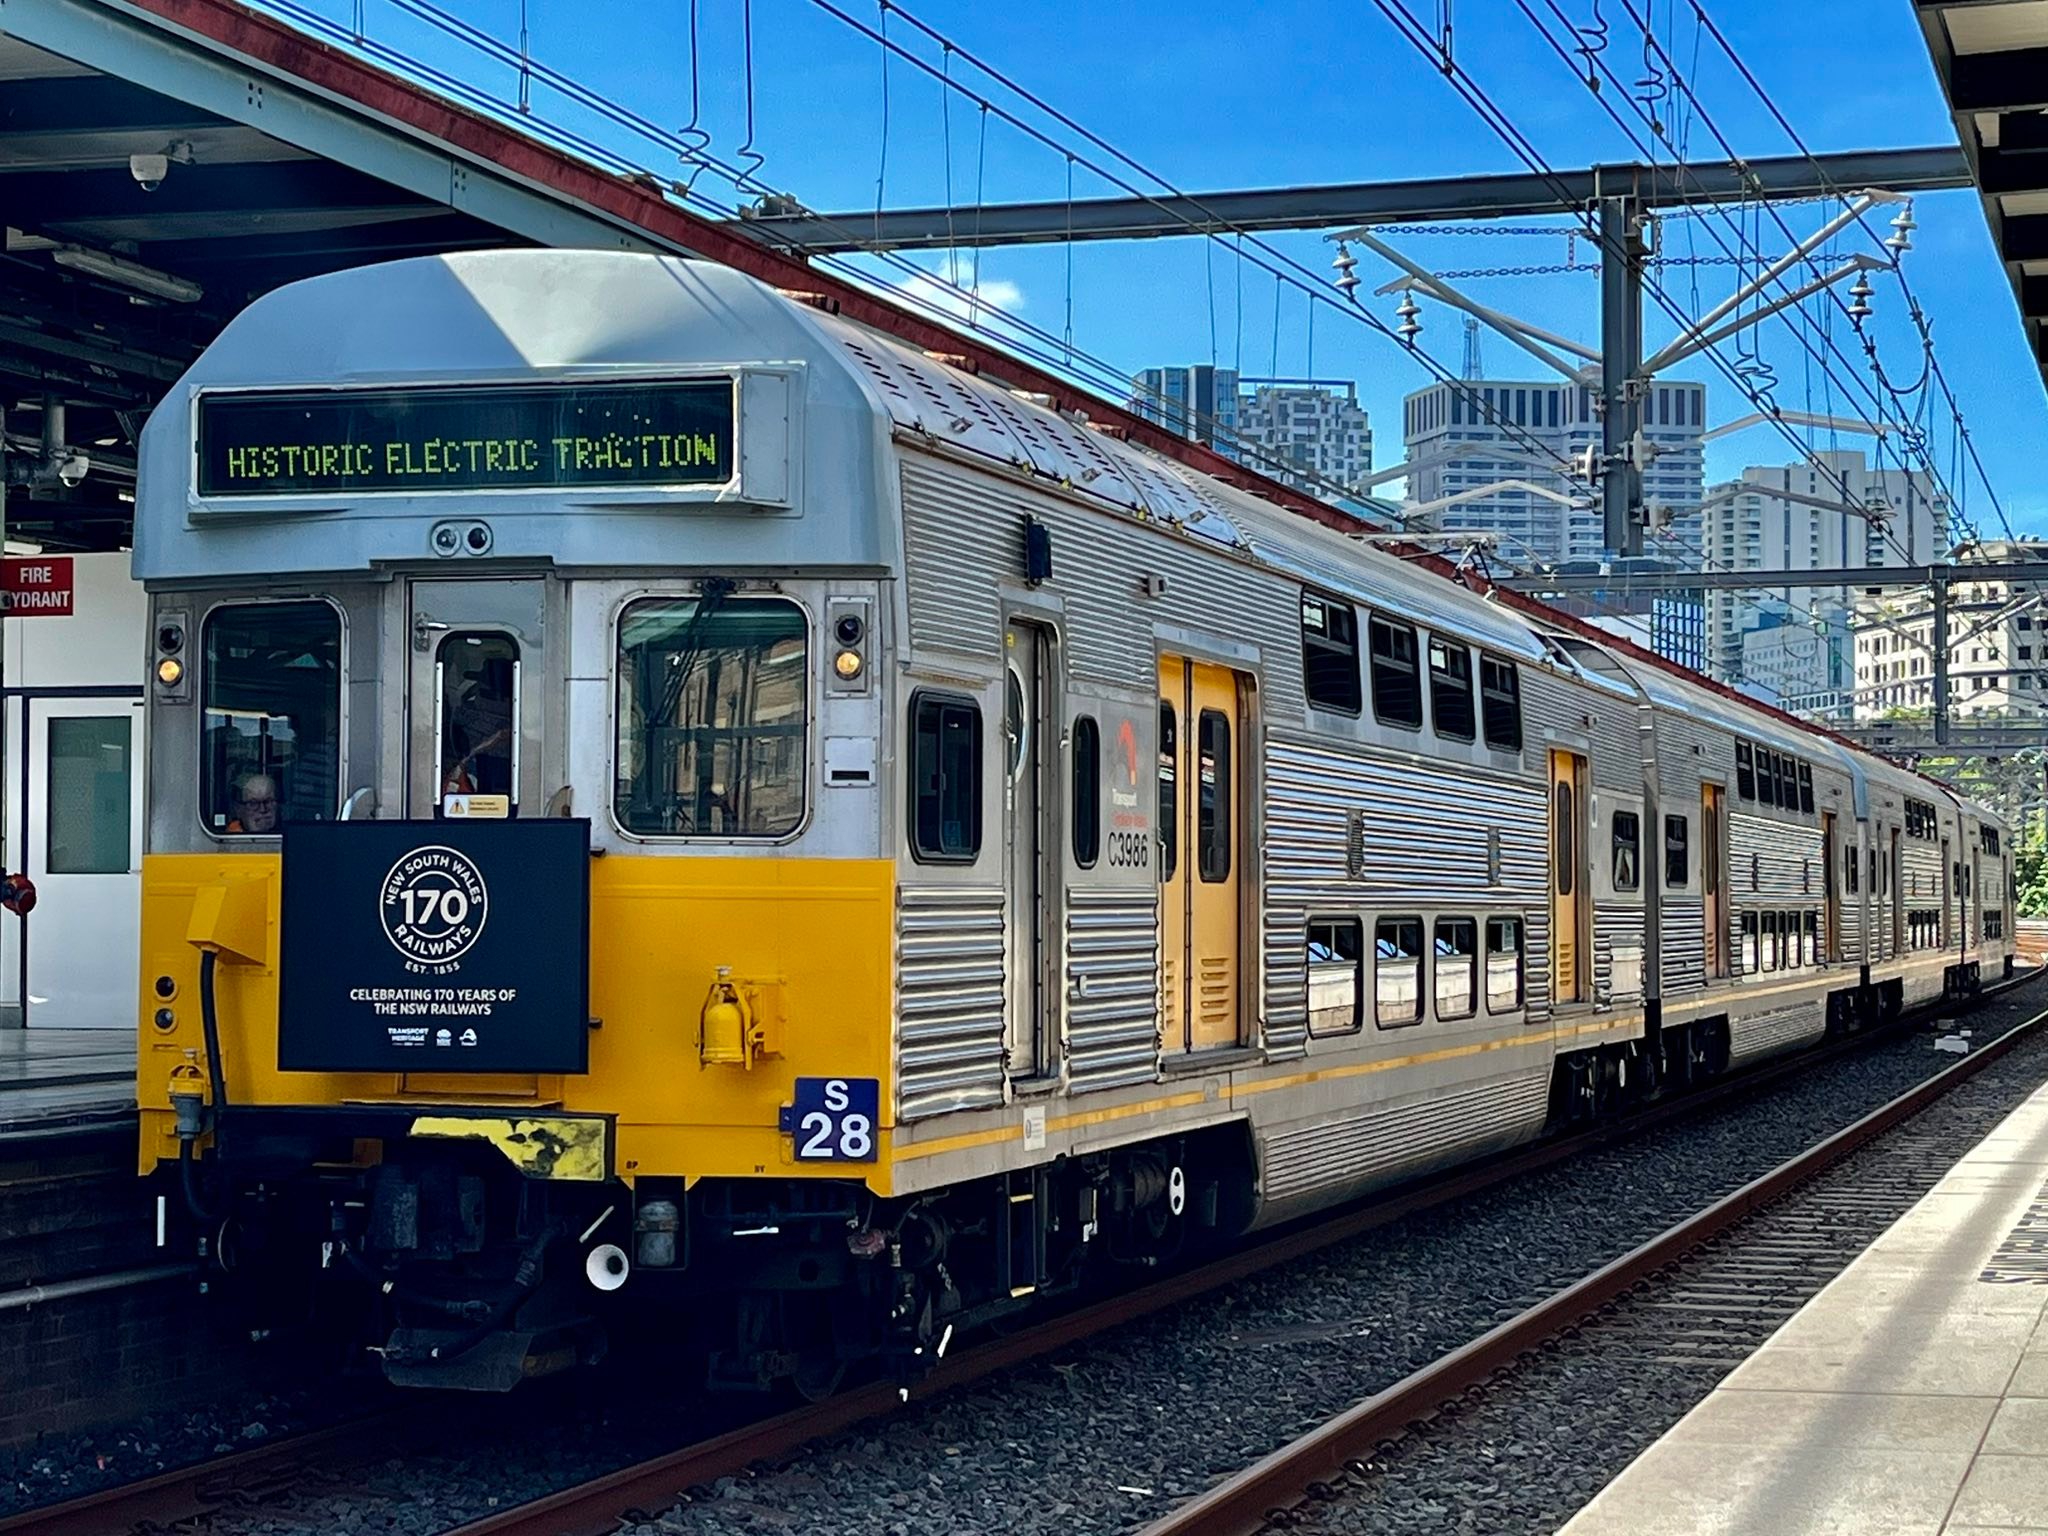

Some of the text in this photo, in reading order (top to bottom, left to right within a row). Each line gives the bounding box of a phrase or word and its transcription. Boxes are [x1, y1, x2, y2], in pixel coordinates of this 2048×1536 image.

[228, 432, 716, 478] HISTORIC ELECTRIC TRACTION
[20, 566, 52, 583] FIRE
[8, 591, 70, 608] YDRANT
[1108, 832, 1148, 867] C3986
[385, 854, 482, 905] NEW SOUTH WALES
[400, 889, 468, 924] 170
[394, 923, 472, 956] RAILWAYS
[405, 961, 461, 975] EST. 1855
[350, 989, 516, 1001] CELEBRATING 170 YEARS OF
[374, 1003, 492, 1015] THE NSW RAILWAYS
[824, 1080, 849, 1111] S
[800, 1112, 871, 1157] 28
